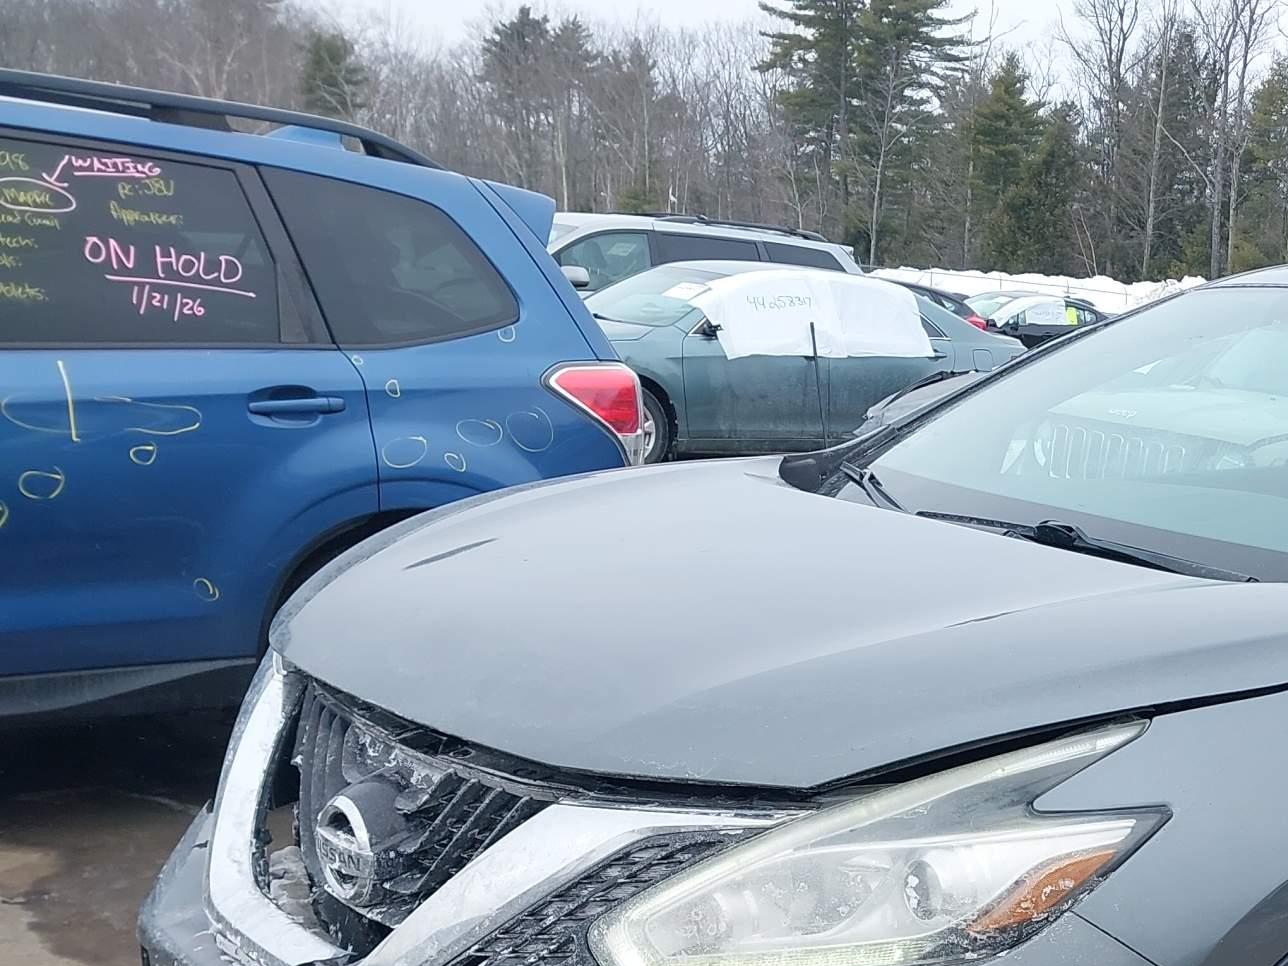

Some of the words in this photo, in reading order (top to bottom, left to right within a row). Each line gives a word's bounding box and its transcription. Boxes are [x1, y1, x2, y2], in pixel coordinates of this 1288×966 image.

[71, 155, 162, 176] WAITING
[84, 236, 135, 270] ON
[155, 245, 243, 283] HOLD
[131, 284, 205, 321] 1/21/26
[317, 836, 361, 873] ISSAN
